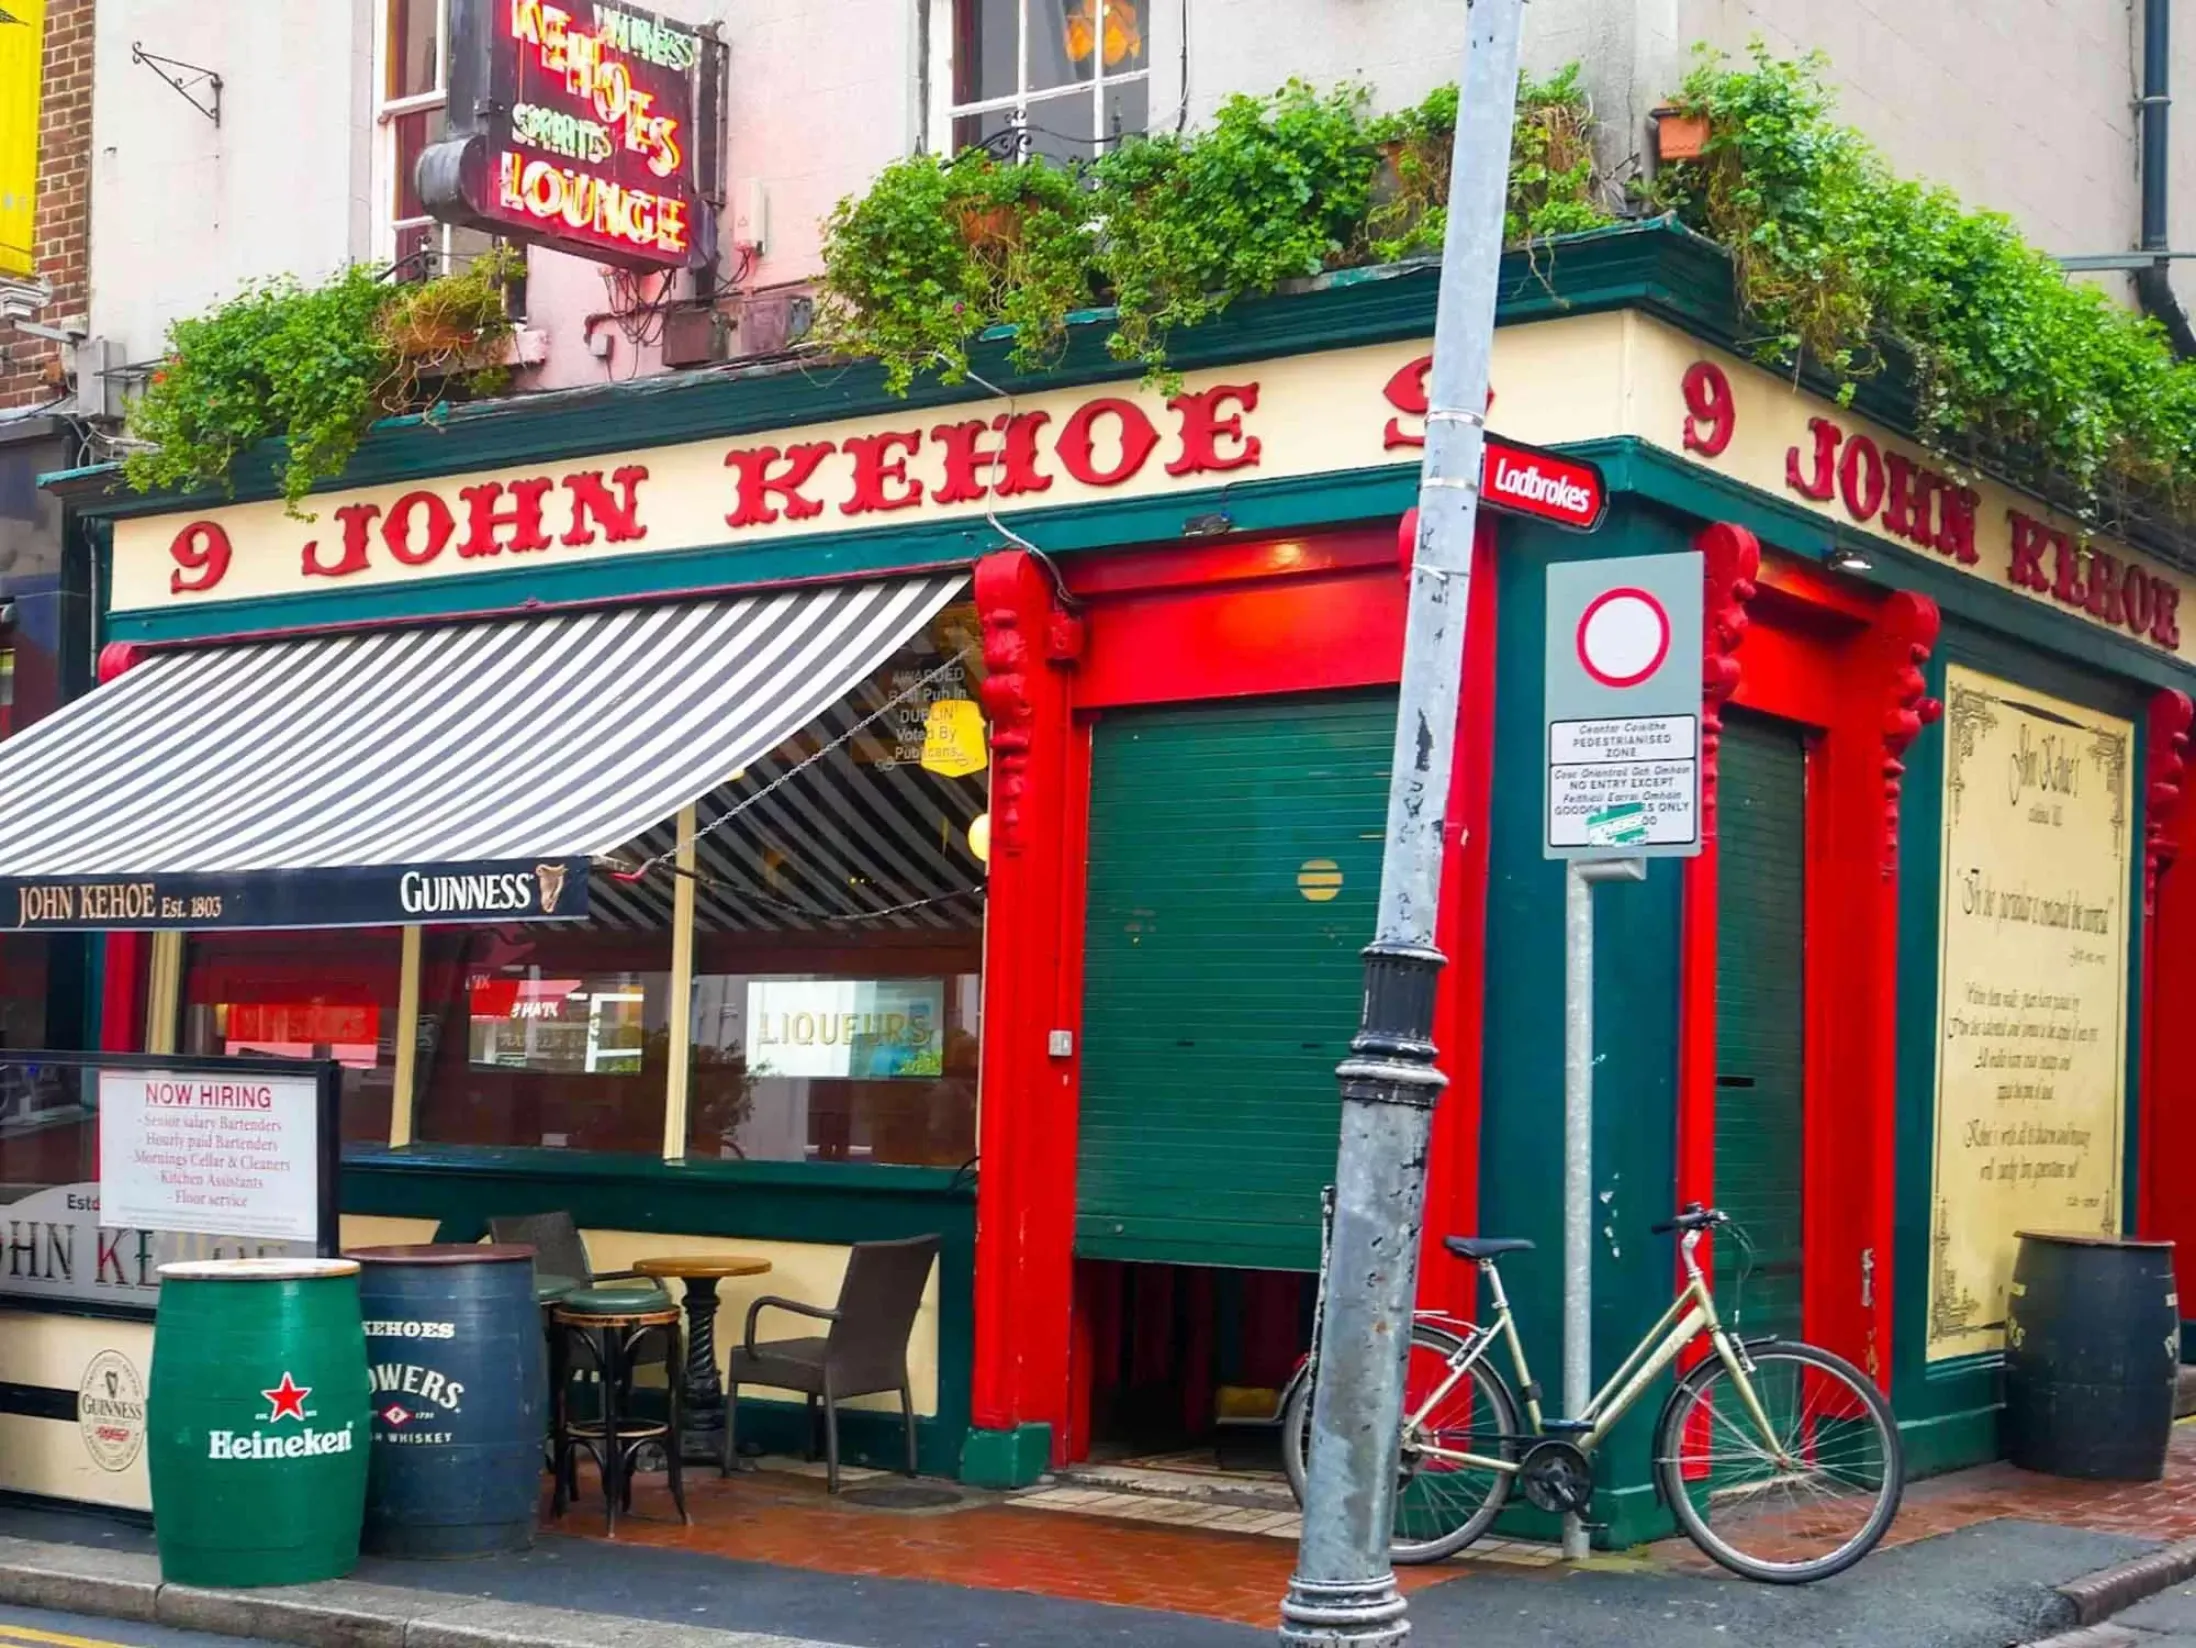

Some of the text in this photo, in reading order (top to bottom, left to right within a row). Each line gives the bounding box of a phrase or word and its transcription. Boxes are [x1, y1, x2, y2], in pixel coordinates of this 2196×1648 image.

[500, 151, 687, 252] LOUNGE
[169, 520, 233, 594] 9
[301, 464, 650, 578] JOHN
[724, 381, 1262, 528] KEHOE
[1494, 458, 1591, 513] Ladbrokes
[1681, 360, 2181, 650] 9 JOHN KEHOE
[889, 689, 921, 703] Bst
[896, 726, 957, 743] Voted By
[1573, 734, 1672, 747] PEDESTRIANISED
[1606, 747, 1637, 758] ZONE
[1569, 777, 1674, 791] NO ENTRY EXCEPT
[1658, 802, 1690, 812] ONLY
[400, 871, 533, 913] GUINNESS
[17, 886, 73, 929] JOHN
[79, 883, 156, 920] KEHOE
[161, 897, 187, 918] Est.
[759, 1011, 931, 1047] LIQUEURS
[145, 1083, 272, 1108] NOW HIRING
[144, 1114, 282, 1132] Senior salary Bartenders
[146, 1132, 278, 1152] Hourly paid Bartenders
[134, 1150, 291, 1172] Mornings Cellar & Cleaners
[160, 1170, 263, 1188] Kitchen Assistants
[175, 1190, 248, 1208] Floor service
[0, 1220, 75, 1280] HN
[369, 1363, 465, 1410] WERS
[82, 1394, 144, 1420] GUINNESS
[209, 1427, 353, 1459] Heineken
[387, 1432, 453, 1444] WHISKEY
